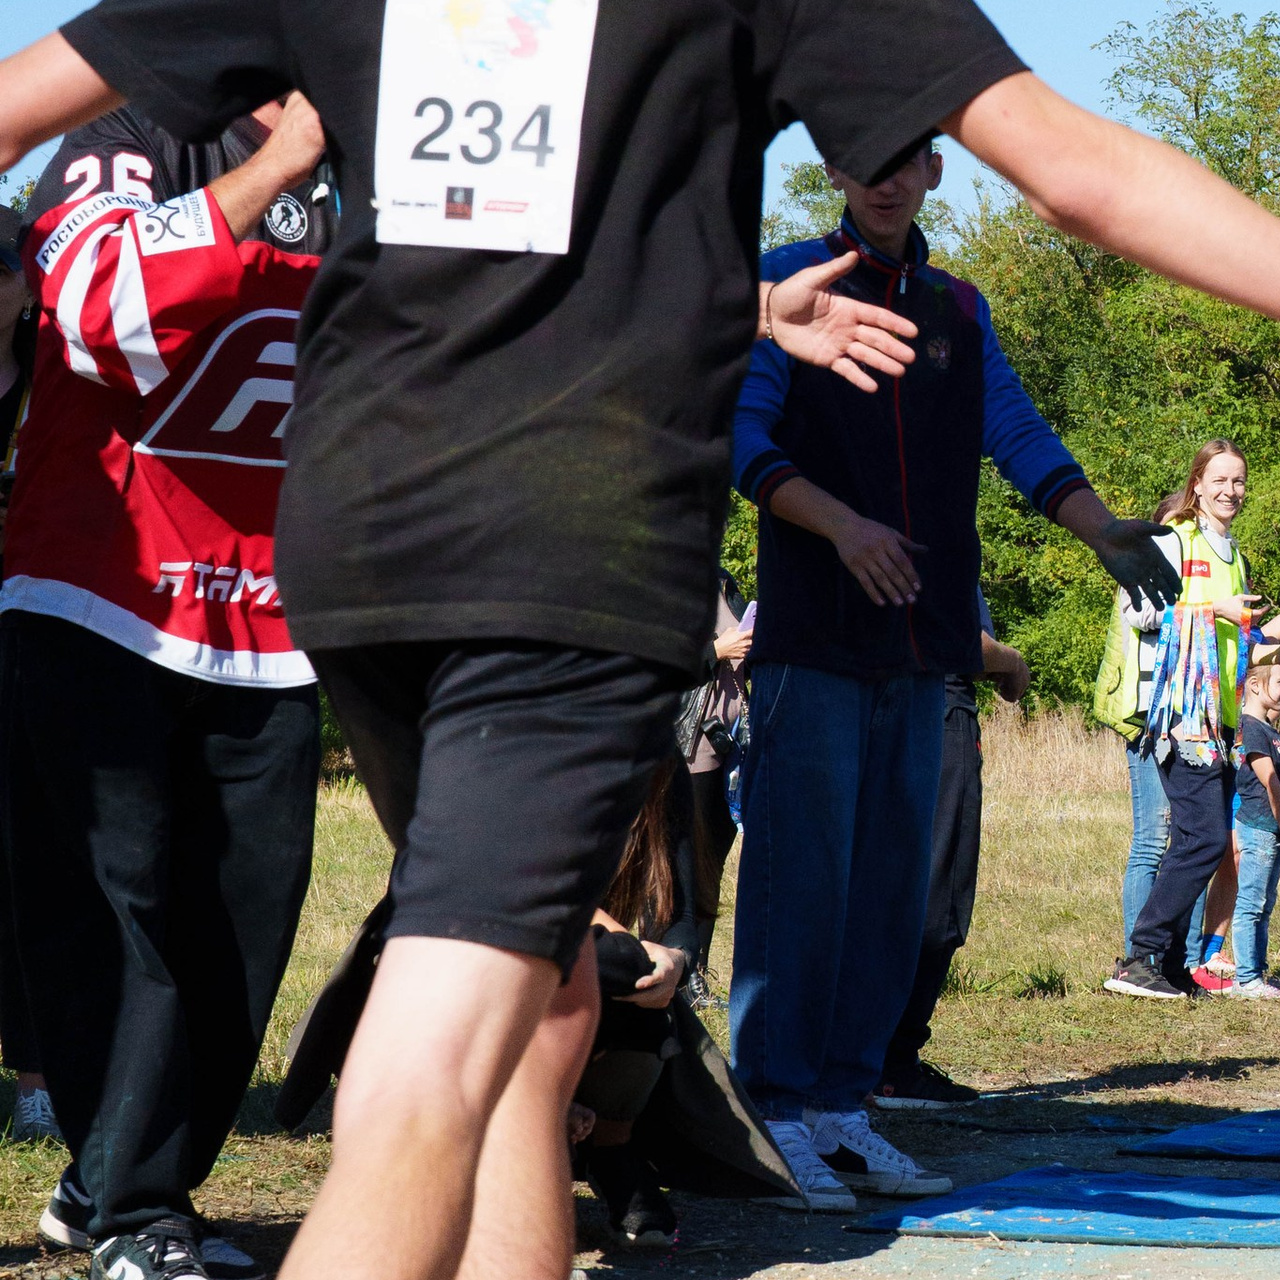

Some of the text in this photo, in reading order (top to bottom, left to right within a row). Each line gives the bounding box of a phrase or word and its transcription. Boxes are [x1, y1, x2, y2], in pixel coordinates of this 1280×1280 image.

[410, 97, 555, 167] 234
[64, 152, 153, 204] 26
[152, 561, 282, 606] АТАМ
